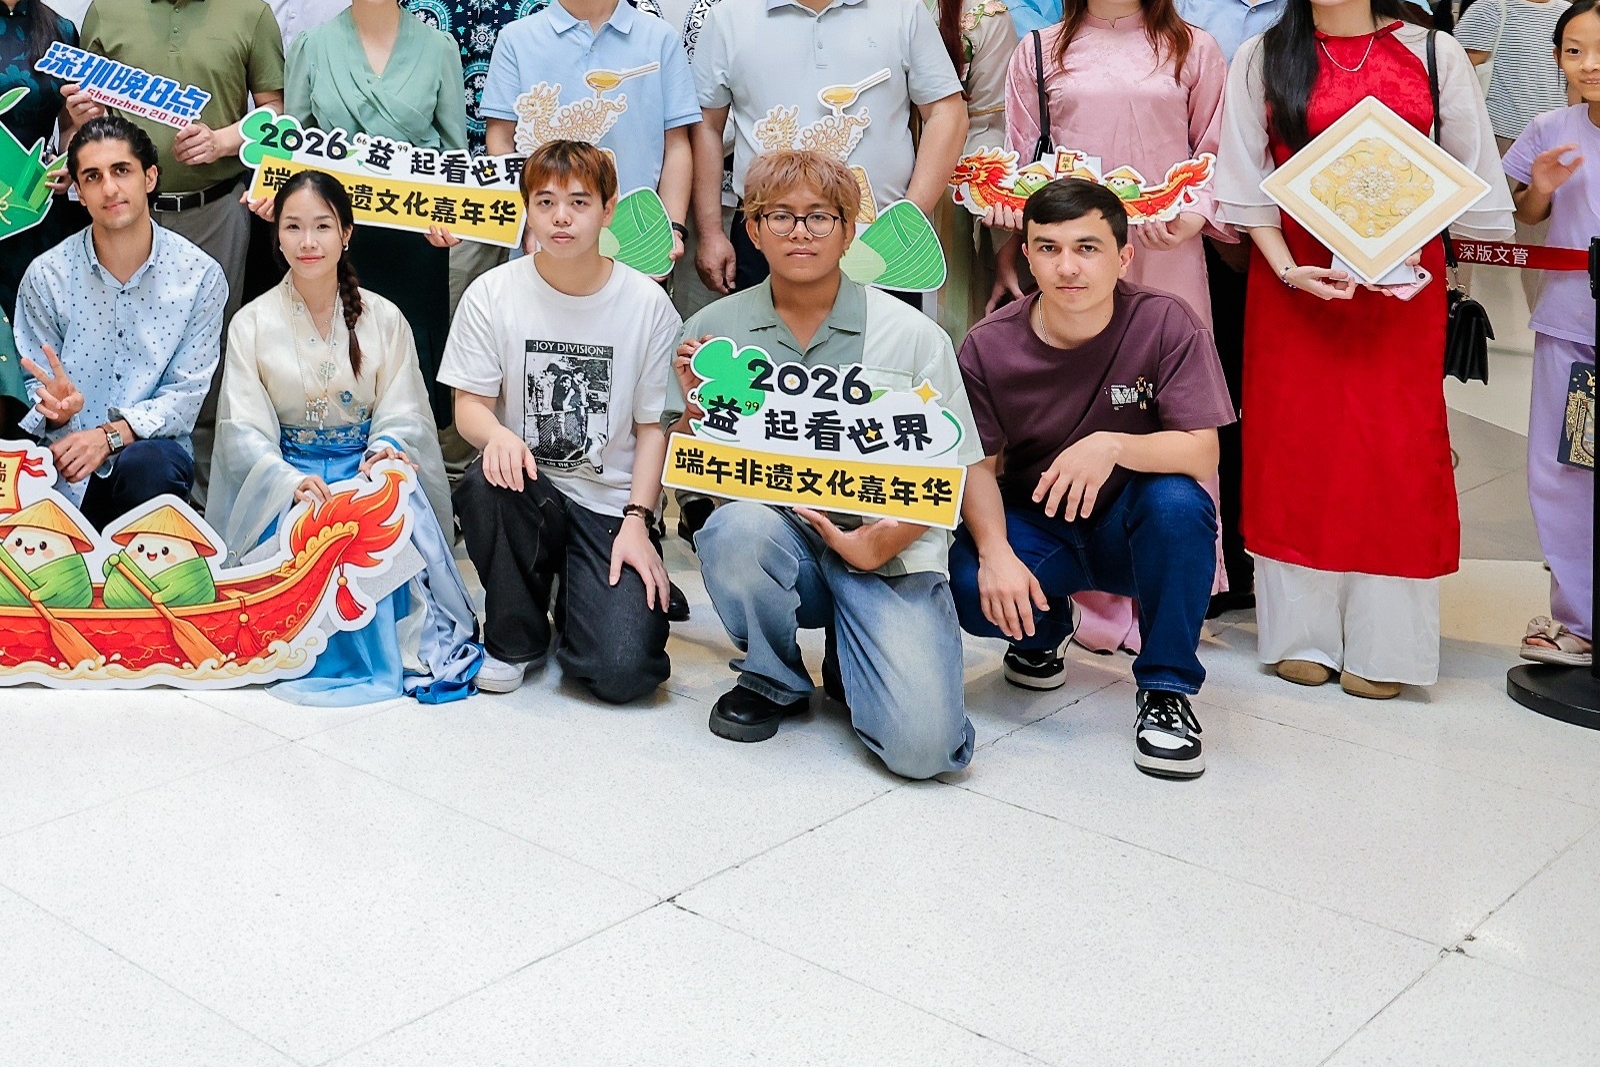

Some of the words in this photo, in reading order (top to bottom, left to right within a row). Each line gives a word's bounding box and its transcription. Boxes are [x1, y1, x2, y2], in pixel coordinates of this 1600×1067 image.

[87, 87, 147, 115] Shenzhen
[149, 109, 190, 128] 20:00
[259, 123, 348, 160] 2026
[262, 166, 518, 226] 端遗文化嘉年华
[1458, 243, 1529, 266] 深版文管
[747, 358, 873, 406] 2026
[675, 446, 953, 507] 端午非遗文化嘉年华
